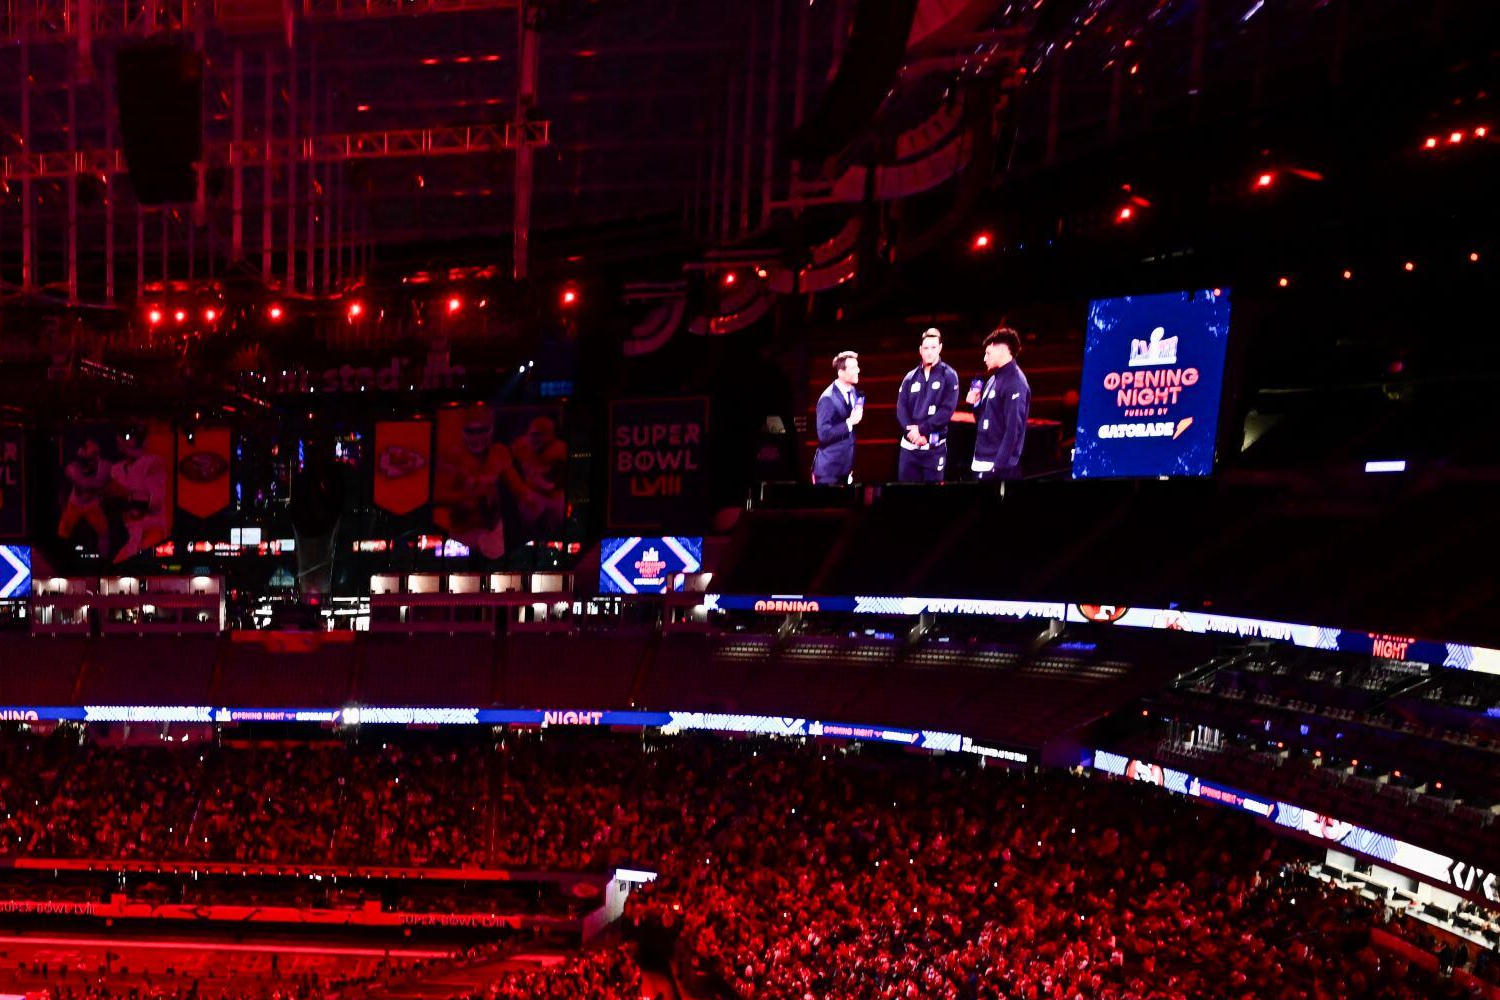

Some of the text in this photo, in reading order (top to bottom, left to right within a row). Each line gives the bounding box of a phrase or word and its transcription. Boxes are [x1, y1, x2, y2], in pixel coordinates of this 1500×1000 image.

[1103, 368, 1199, 390] OPENING
[1117, 387, 1182, 407] NIGHT
[615, 424, 701, 447] SUPER
[1098, 422, 1174, 439] GATORADE
[617, 449, 698, 472] BOWL
[1372, 639, 1408, 660] NIGHT
[544, 711, 603, 725] NIGHT
